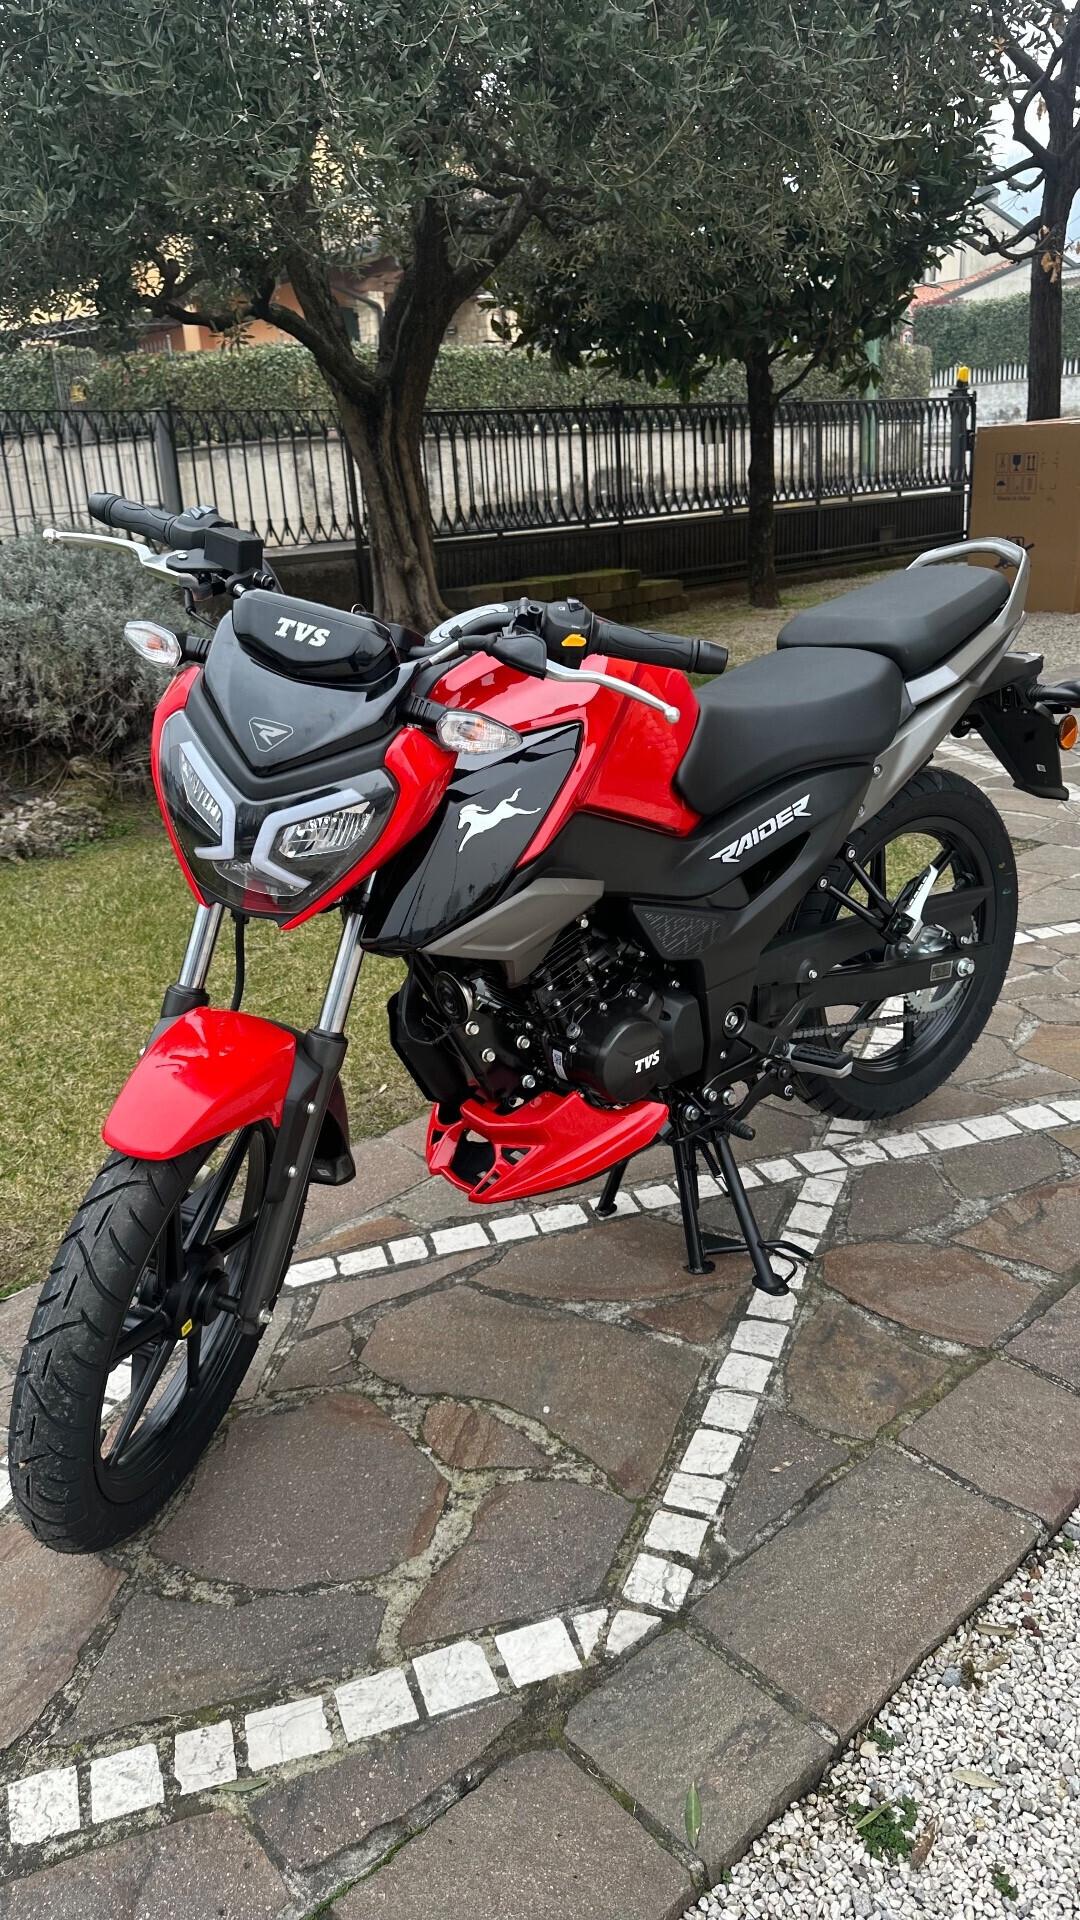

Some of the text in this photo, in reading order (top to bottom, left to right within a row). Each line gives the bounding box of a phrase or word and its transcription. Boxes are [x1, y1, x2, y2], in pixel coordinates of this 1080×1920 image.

[274, 616, 331, 648] TVS
[708, 793, 813, 863] RAIDER
[634, 1049, 660, 1074] TVS
